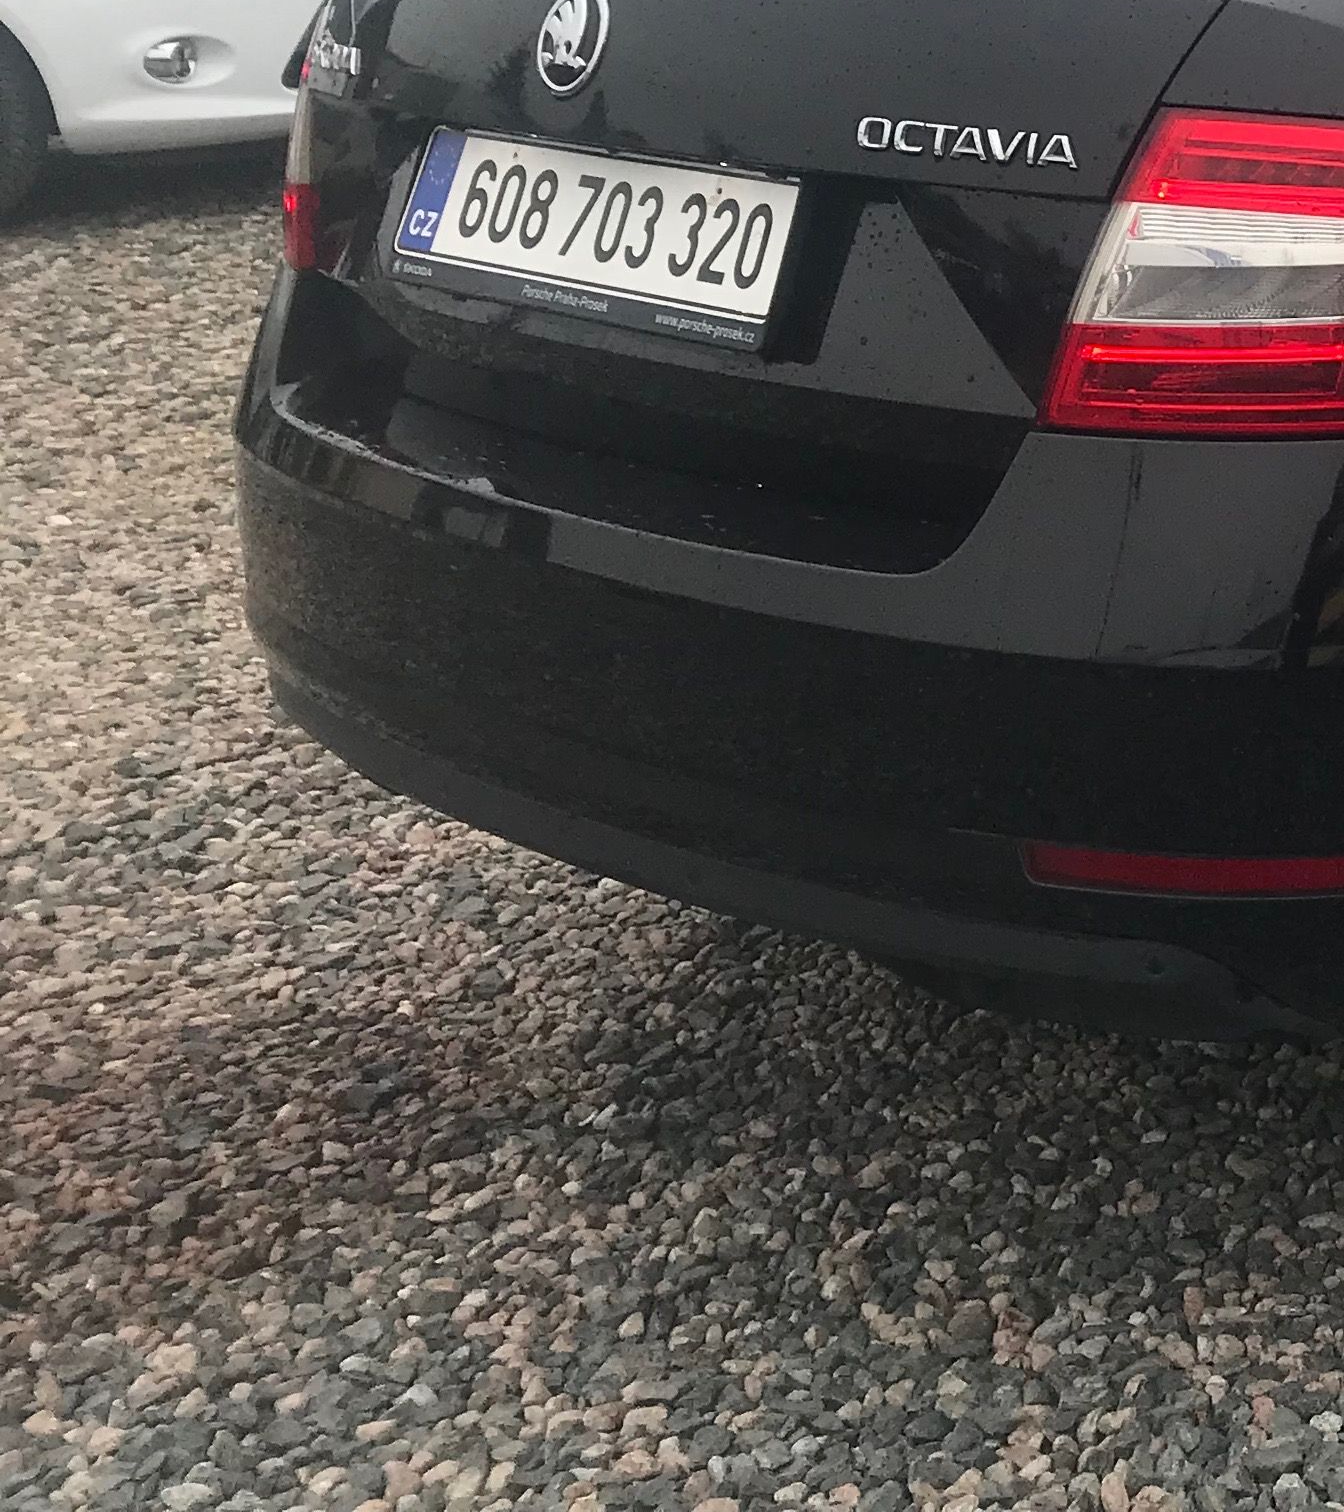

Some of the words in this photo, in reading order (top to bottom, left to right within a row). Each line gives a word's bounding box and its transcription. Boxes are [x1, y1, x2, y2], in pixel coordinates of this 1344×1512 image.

[857, 116, 1078, 169] OCTAVIA
[408, 209, 438, 237] CZ
[458, 159, 559, 249] 608
[558, 174, 663, 269] 703
[668, 193, 773, 289] 320
[655, 314, 755, 343] www.porsche-prosek.cz
